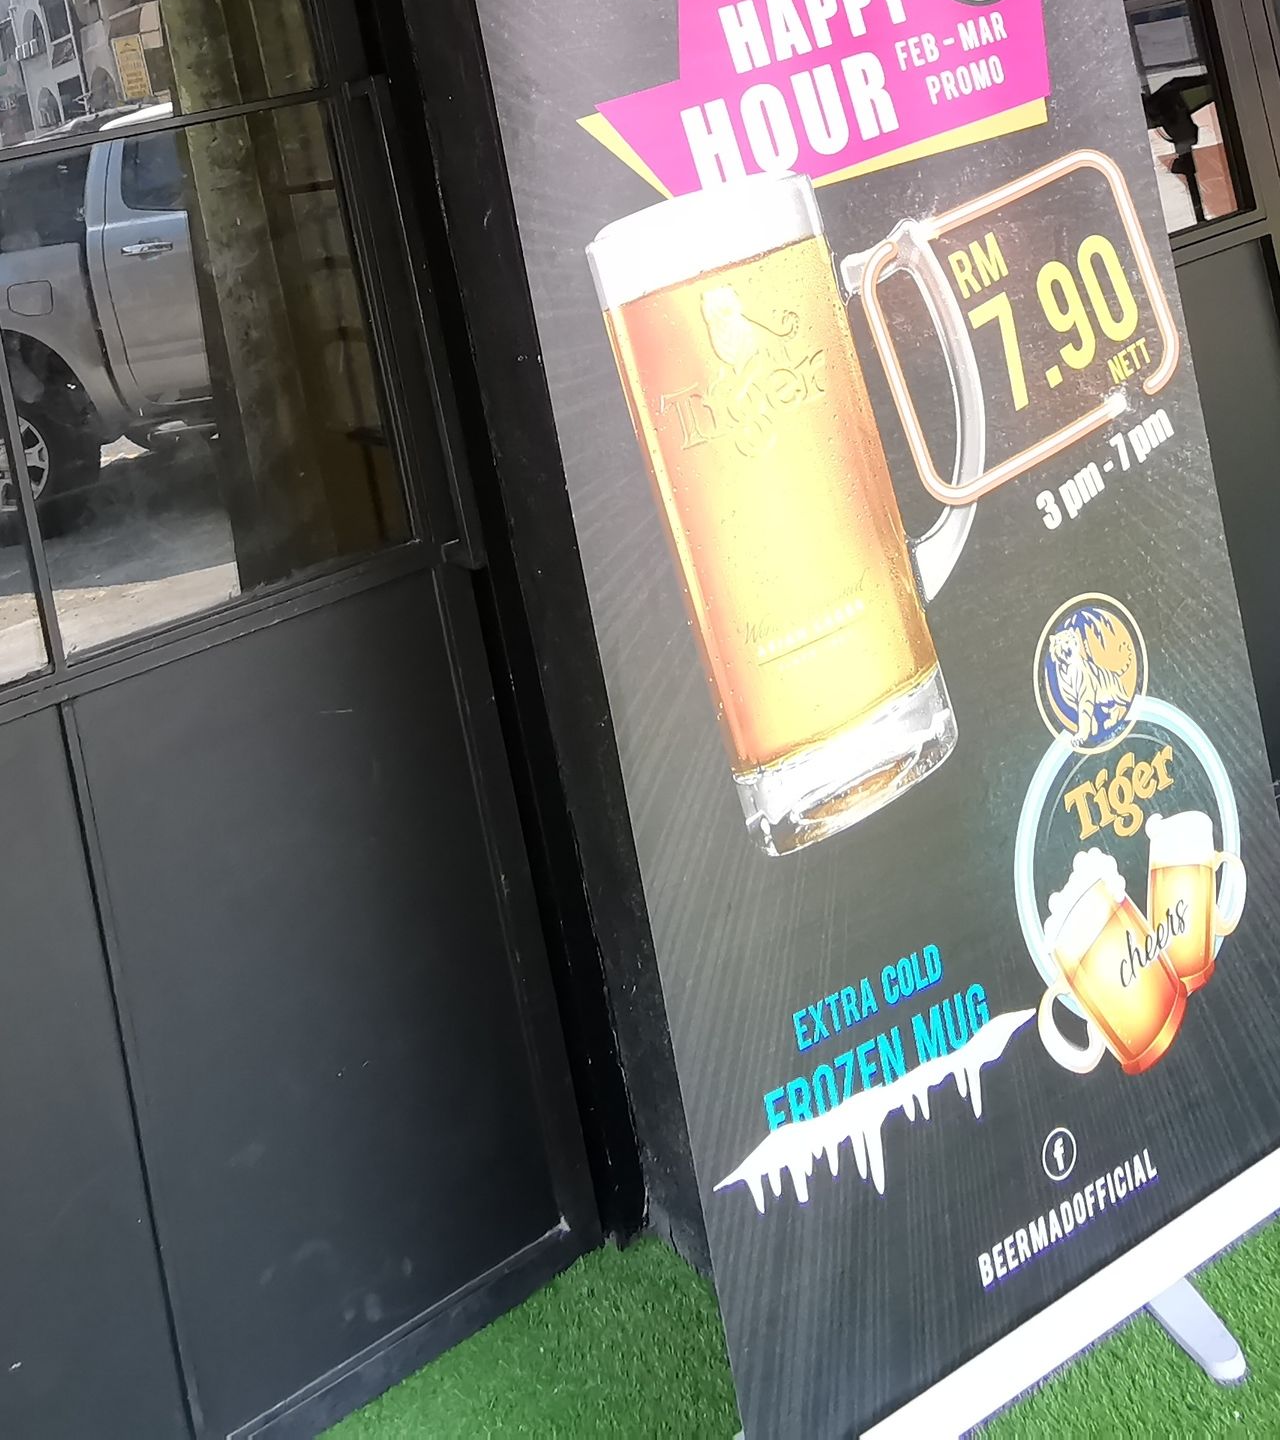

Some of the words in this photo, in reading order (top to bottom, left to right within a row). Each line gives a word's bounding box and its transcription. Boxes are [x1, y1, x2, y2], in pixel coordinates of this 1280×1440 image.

[894, 32, 940, 71] FEB
[957, 11, 1008, 52] MAR
[924, 55, 1006, 105] PROMO
[680, 52, 900, 190] HOUR
[947, 231, 1009, 299] RM
[968, 234, 1139, 412] 7.90
[1107, 336, 1151, 384] NETT
[1035, 489, 1062, 530] 3
[1058, 461, 1105, 519] pm
[1109, 431, 1131, 472] 7
[1127, 408, 1175, 464] pm
[1063, 745, 1175, 841] Tiger
[1120, 899, 1189, 988] cheers
[792, 977, 879, 1051] EXTRA
[881, 944, 943, 1005] COLD
[764, 1026, 908, 1133] FROZEN
[911, 983, 992, 1064] MUG
[977, 1147, 1158, 1288] BEERMADOFFICIAL
